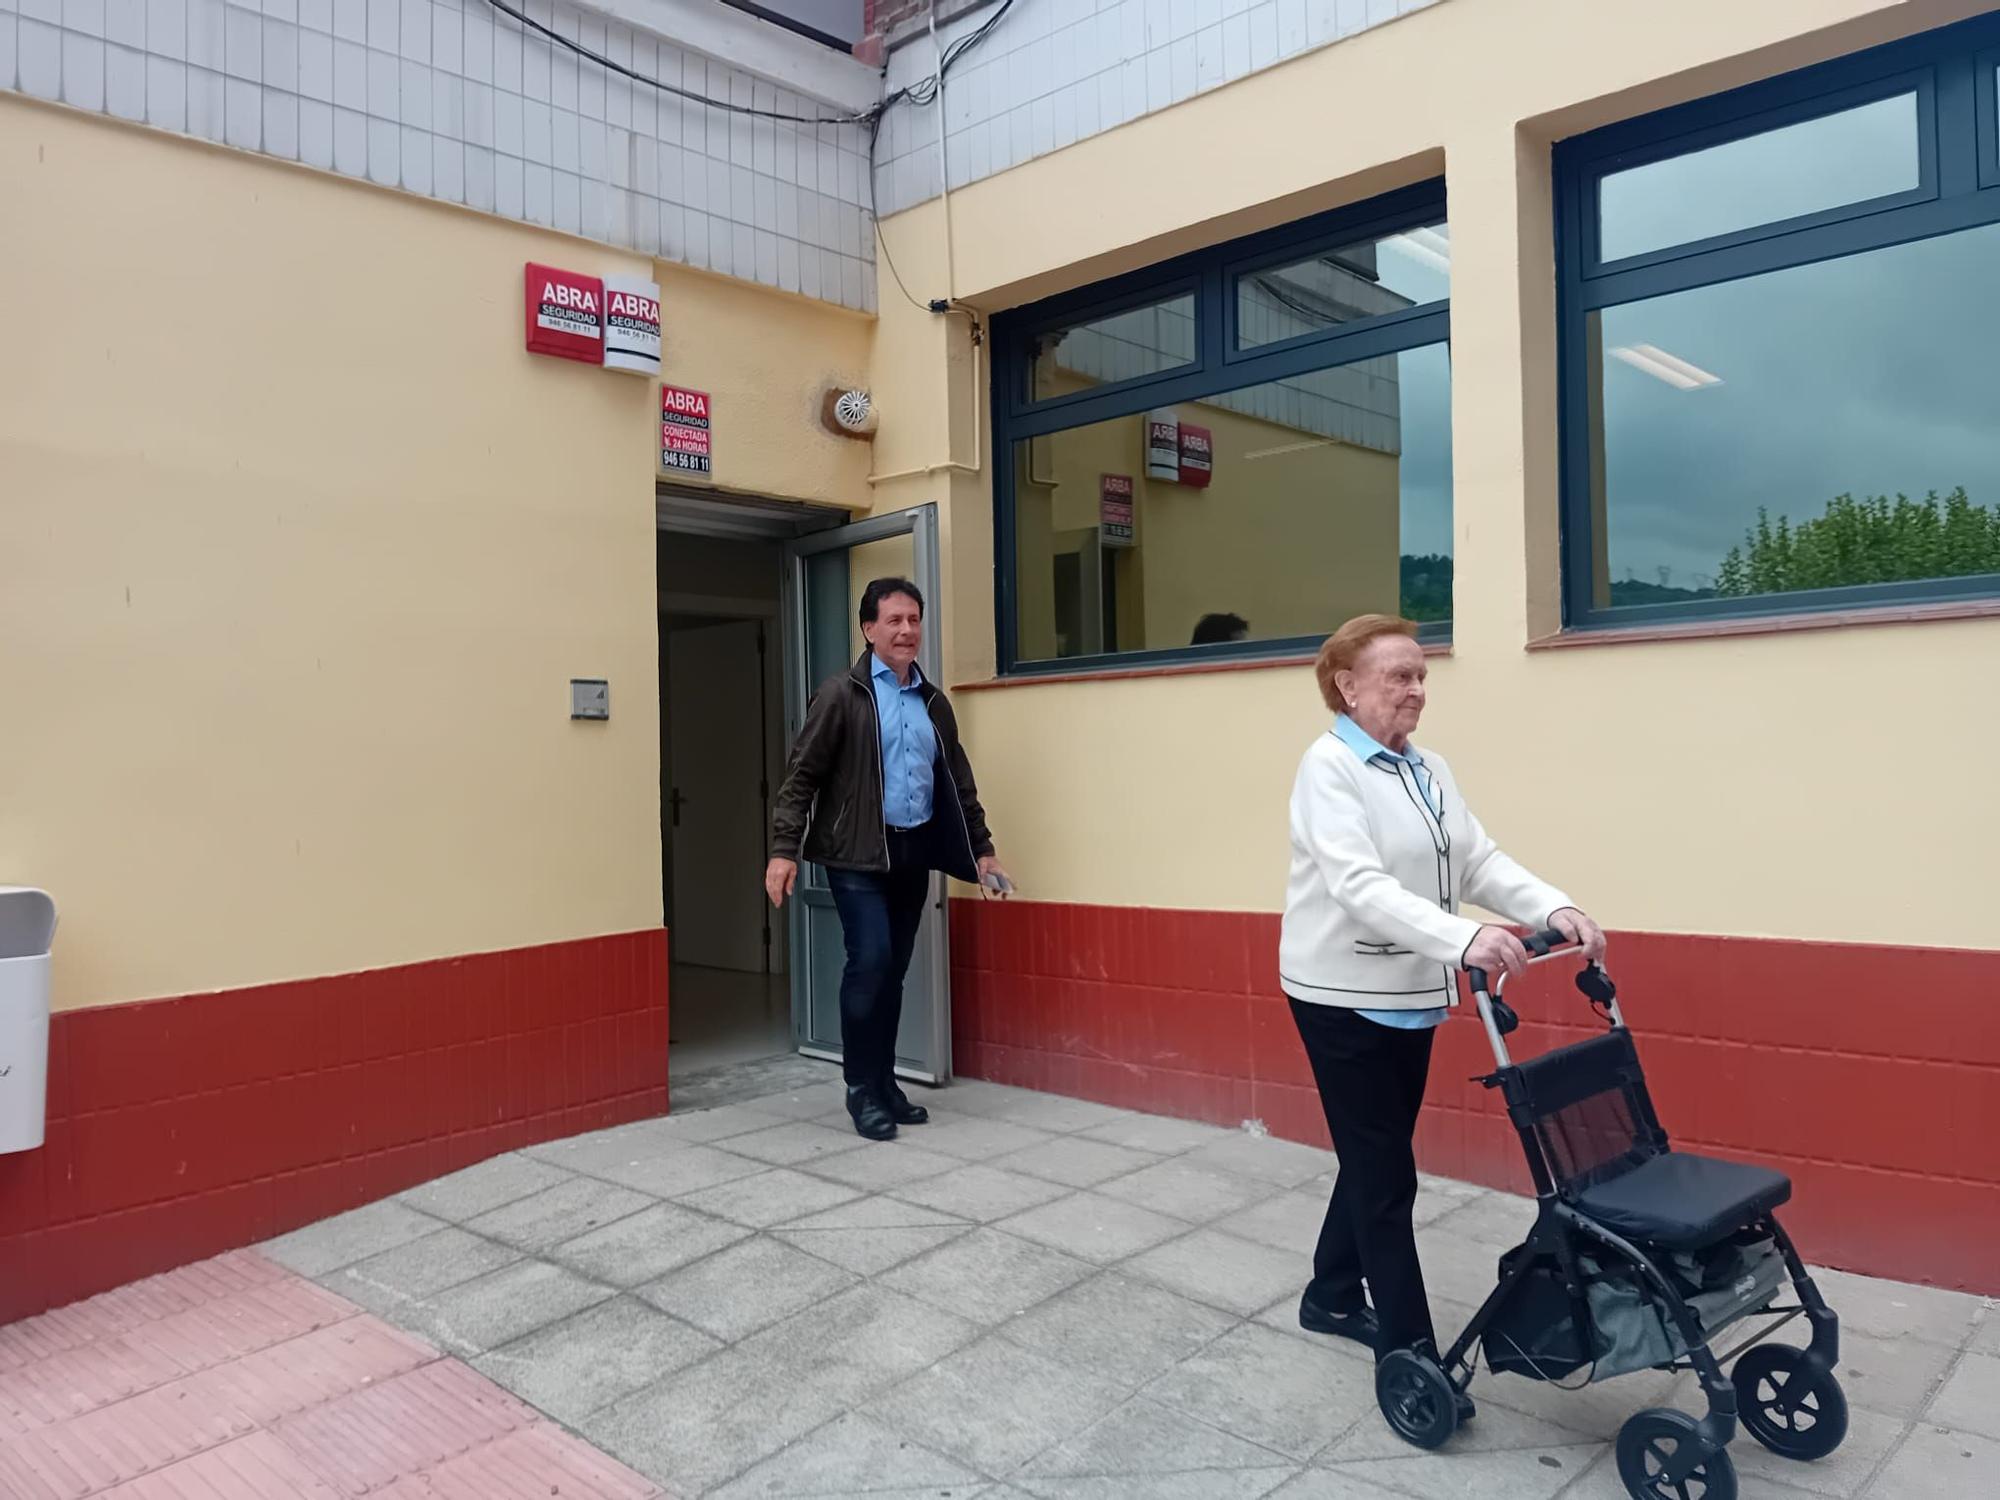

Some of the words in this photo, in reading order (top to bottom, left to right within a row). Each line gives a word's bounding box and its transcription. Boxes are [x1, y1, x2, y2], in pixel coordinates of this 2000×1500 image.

[543, 281, 596, 312] ABRA
[542, 304, 597, 325] SEGURIDAD
[611, 294, 660, 322] ABRA
[548, 318, 561, 327] 946
[563, 321, 571, 329] 56
[573, 323, 582, 331] 81
[583, 325, 591, 333] 11
[611, 315, 660, 335] SEGURIDAD
[665, 390, 706, 415] ABRA
[664, 411, 708, 428] SEGURIDAD
[664, 425, 708, 442] CONECTADA
[673, 438, 681, 448] 24
[682, 440, 708, 454] HORAS
[664, 451, 678, 466] 946
[679, 453, 689, 468] 56
[689, 455, 699, 469] 81
[700, 458, 709, 471] 11
